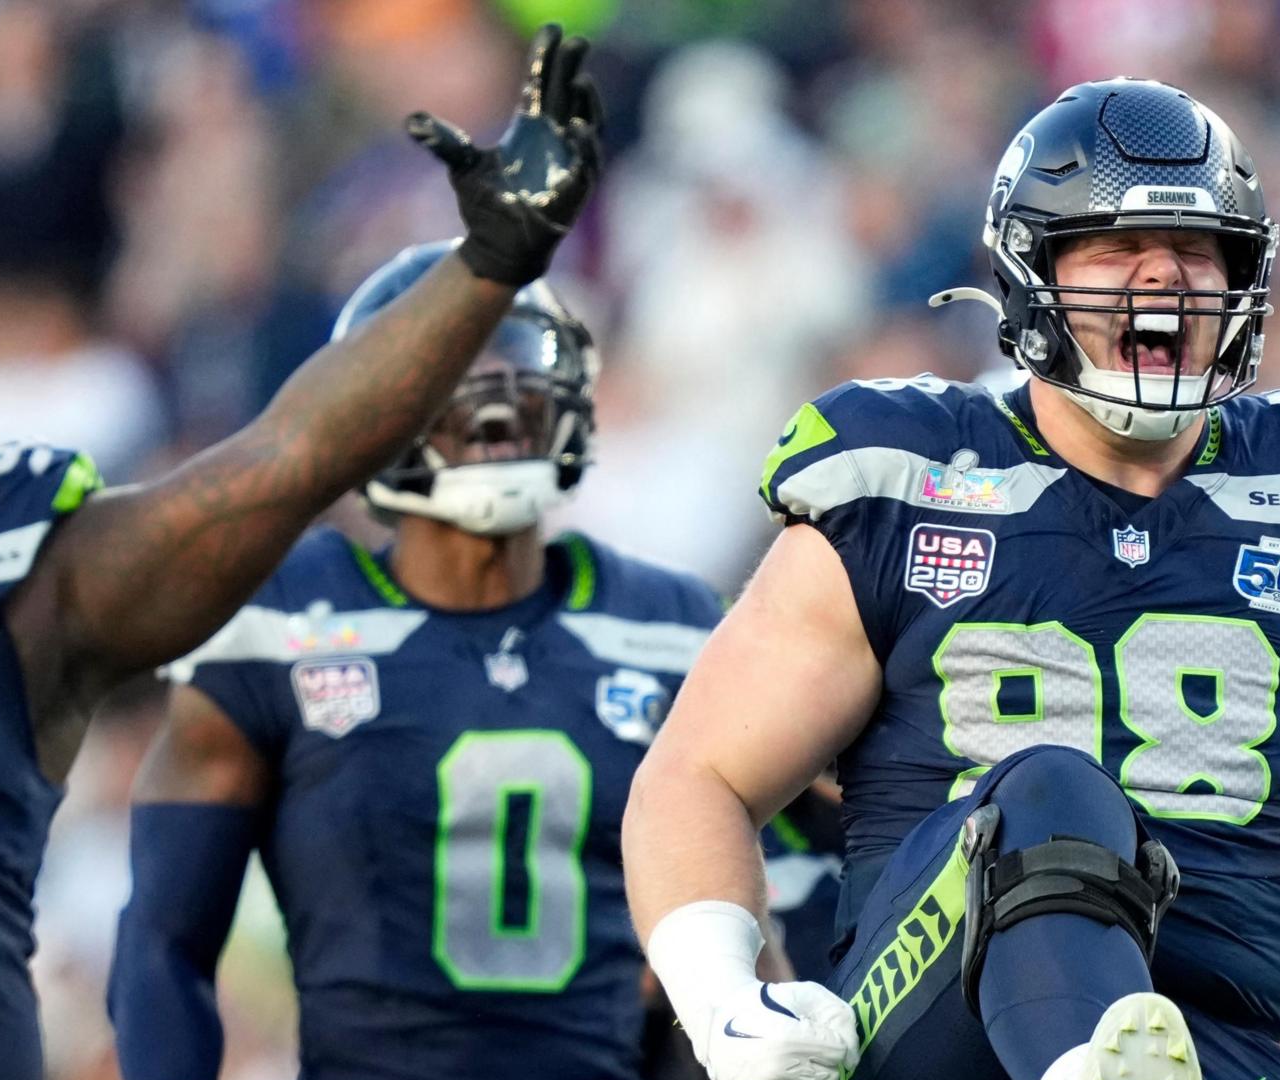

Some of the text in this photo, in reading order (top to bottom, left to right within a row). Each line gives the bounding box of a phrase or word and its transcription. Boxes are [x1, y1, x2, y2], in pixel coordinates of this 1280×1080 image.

[1147, 191, 1196, 204] SEAHAWKS
[930, 497, 963, 506] SUPER
[918, 533, 985, 557] USA
[1121, 542, 1146, 560] NFL
[910, 565, 984, 591] 250
[933, 612, 1280, 827] 98
[432, 729, 592, 993] 0
